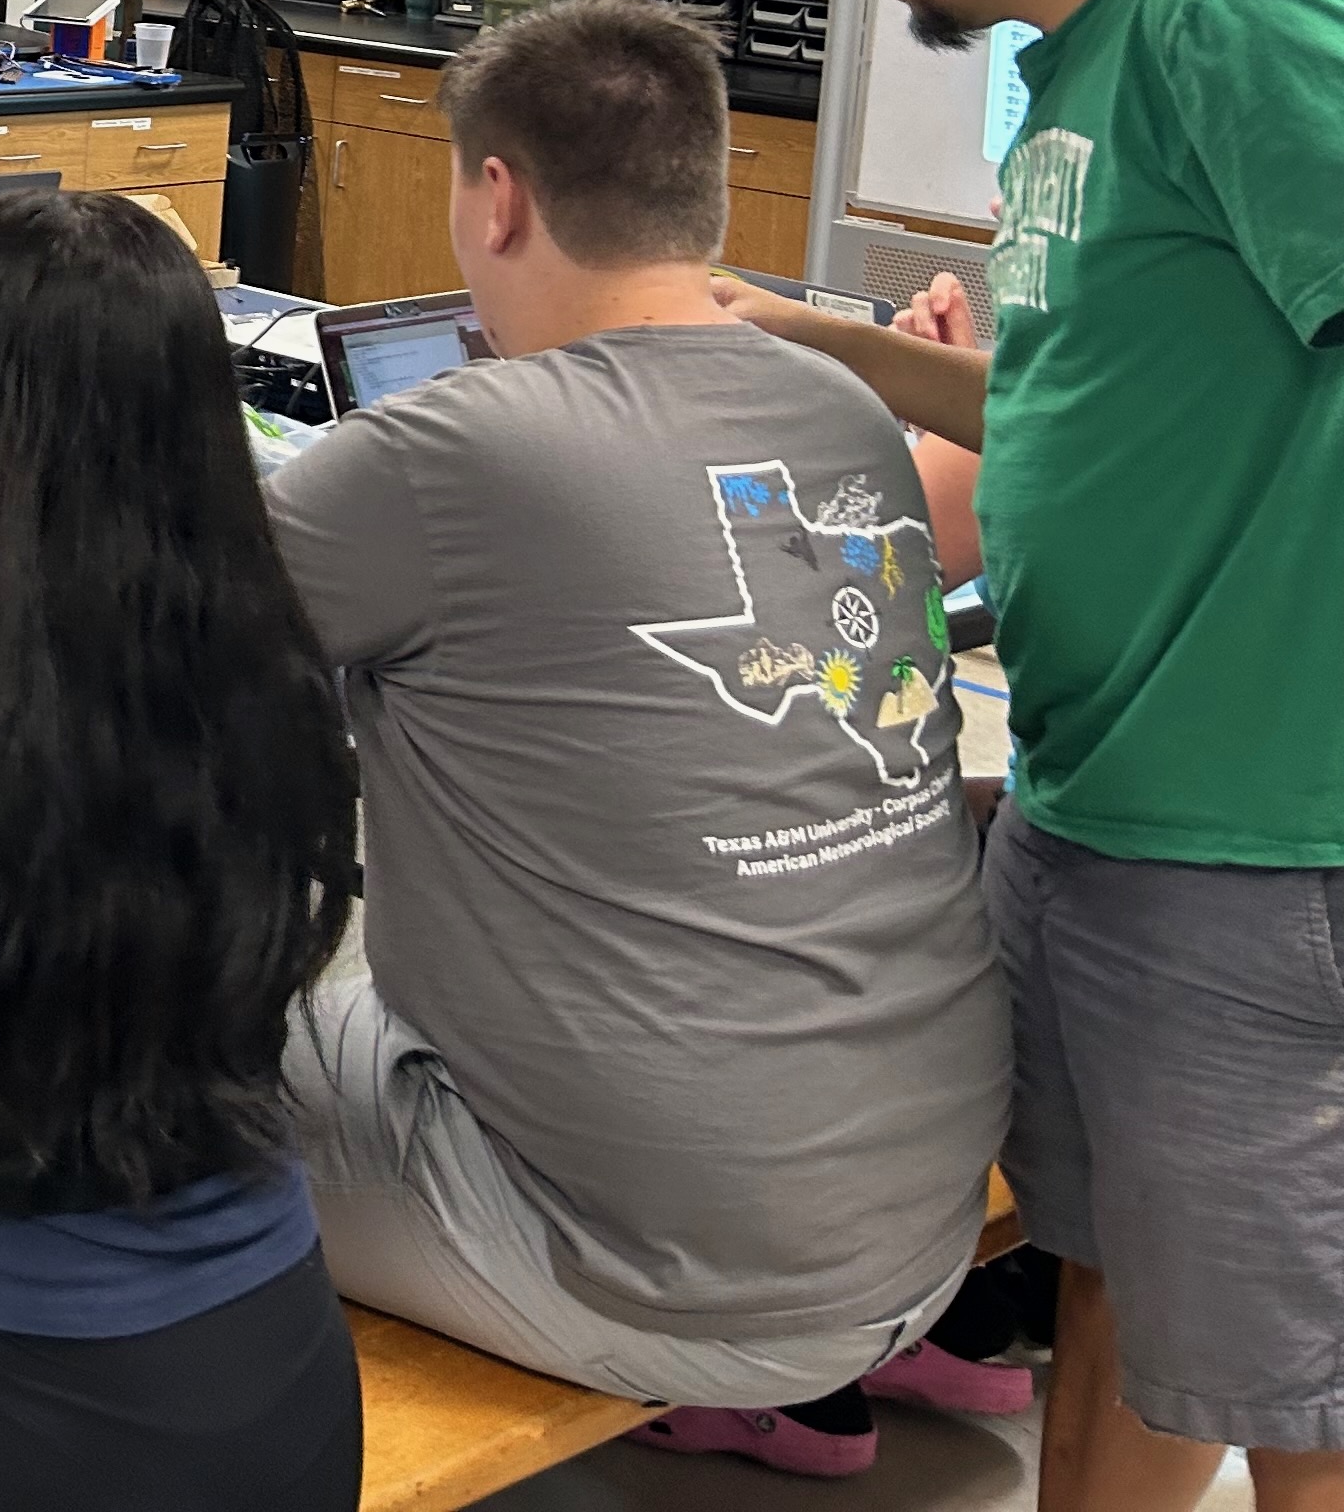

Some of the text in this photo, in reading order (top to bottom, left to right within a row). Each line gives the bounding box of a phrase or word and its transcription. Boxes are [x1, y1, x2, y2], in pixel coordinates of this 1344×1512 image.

[702, 835, 763, 854] Texas
[764, 826, 807, 848] A&M
[736, 854, 818, 877] American
